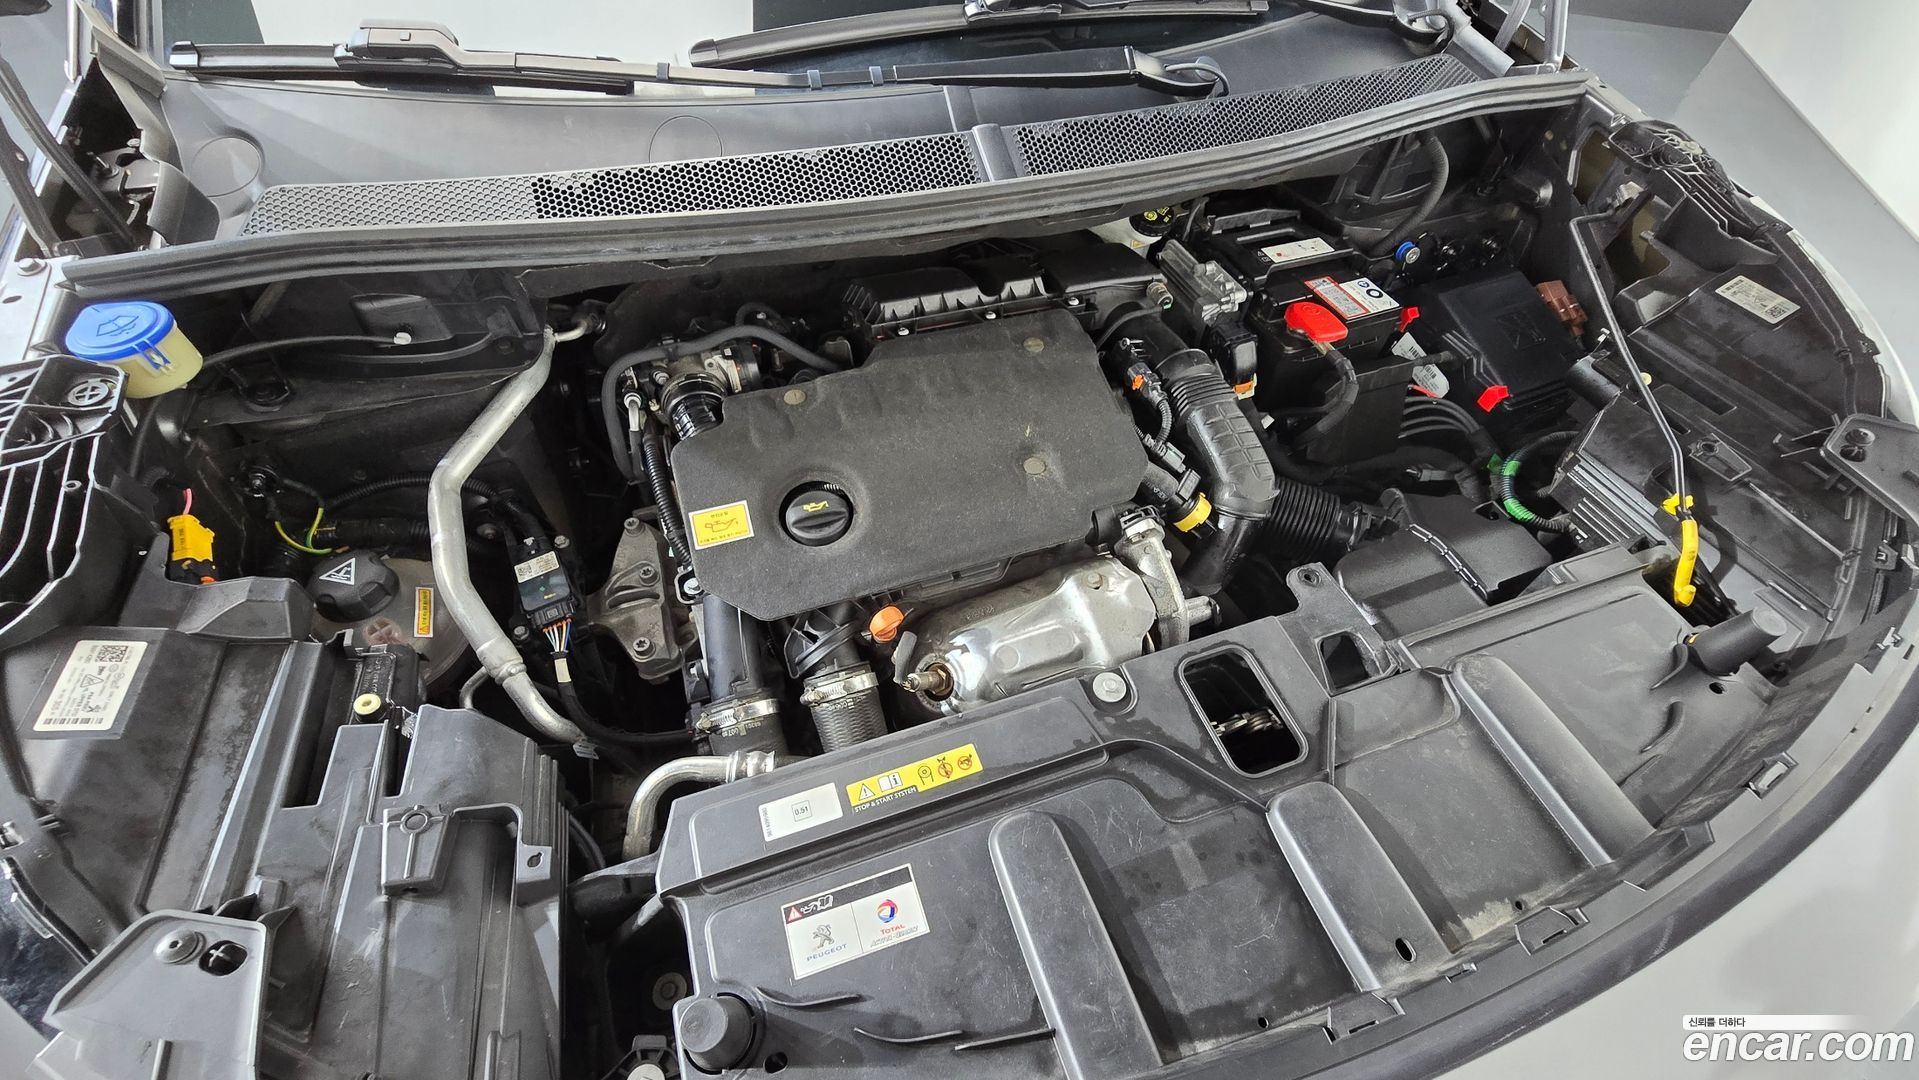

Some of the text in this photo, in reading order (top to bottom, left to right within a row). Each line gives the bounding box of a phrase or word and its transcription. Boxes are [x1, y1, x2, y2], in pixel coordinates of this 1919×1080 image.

[854, 804, 870, 813] STOP
[876, 795, 894, 804] START
[894, 787, 917, 798] SYSTEM
[794, 806, 809, 816] 0.51
[880, 924, 905, 935] TOTAL
[806, 943, 848, 961] PEUGEOT
